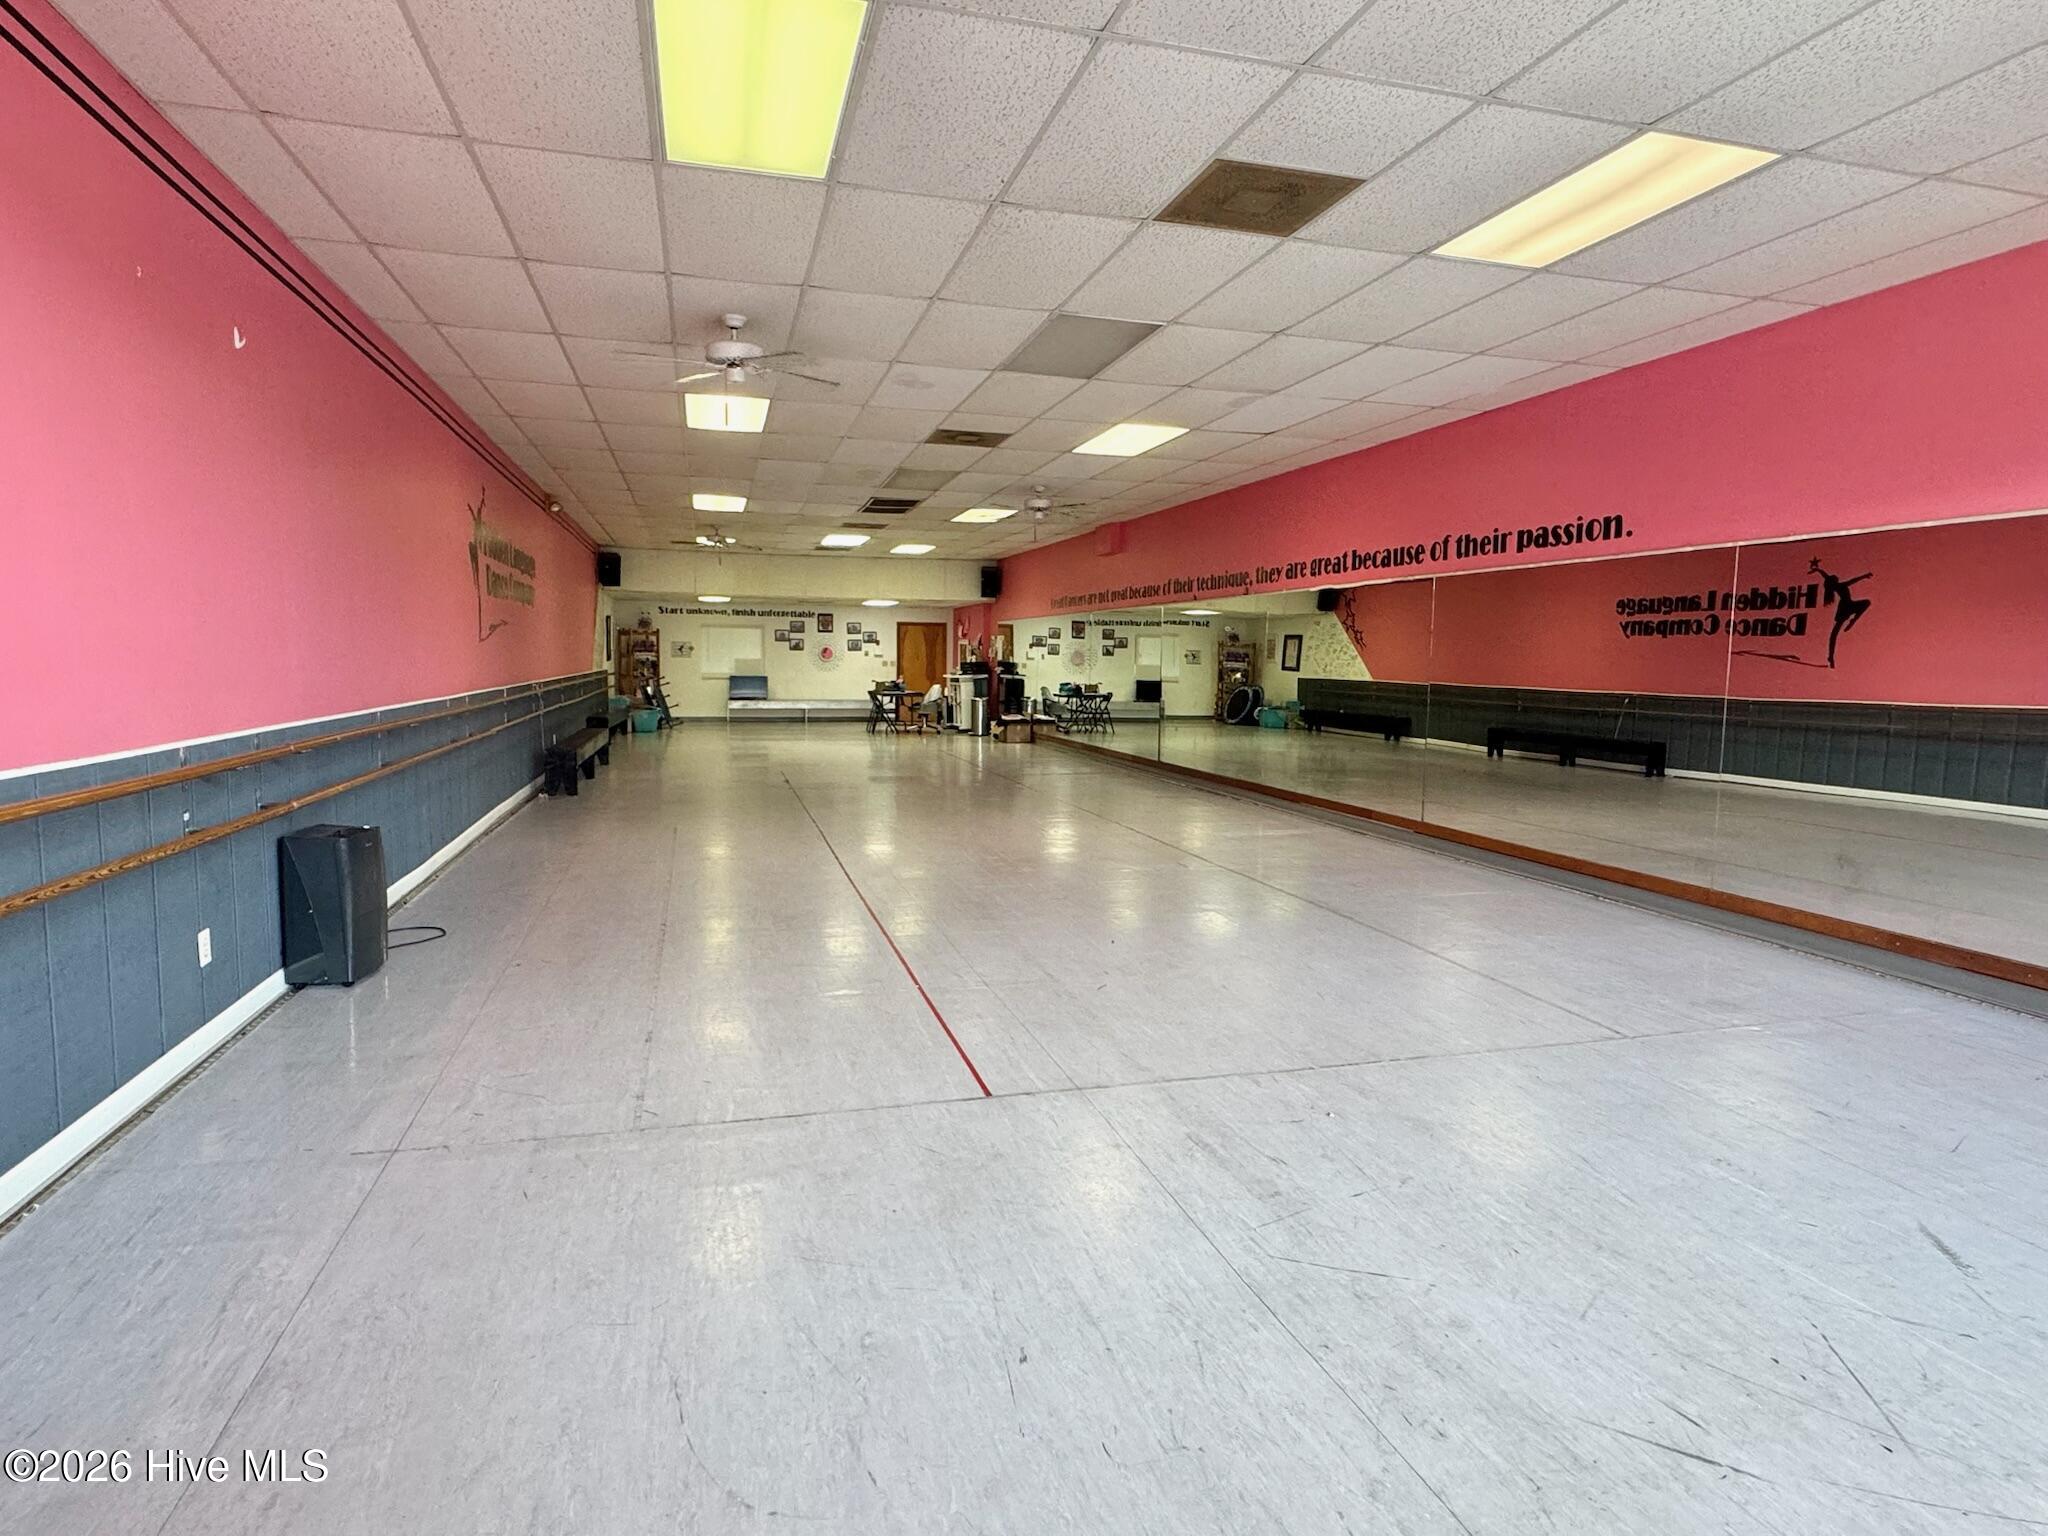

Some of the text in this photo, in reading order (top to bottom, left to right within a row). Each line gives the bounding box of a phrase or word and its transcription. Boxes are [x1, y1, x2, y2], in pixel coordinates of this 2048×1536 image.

[1129, 583, 1160, 600] because
[1162, 578, 1173, 595] of
[1173, 576, 1194, 594] their
[1196, 570, 1253, 592] technique,
[1255, 566, 1284, 584] they
[1285, 561, 1307, 579] are
[1310, 551, 1349, 578] great
[1352, 543, 1425, 571] because
[1430, 534, 1452, 561] of
[1456, 528, 1512, 560] their
[1516, 514, 1633, 553] passion.
[658, 606, 816, 618] Start unknown, finish unforgettable
